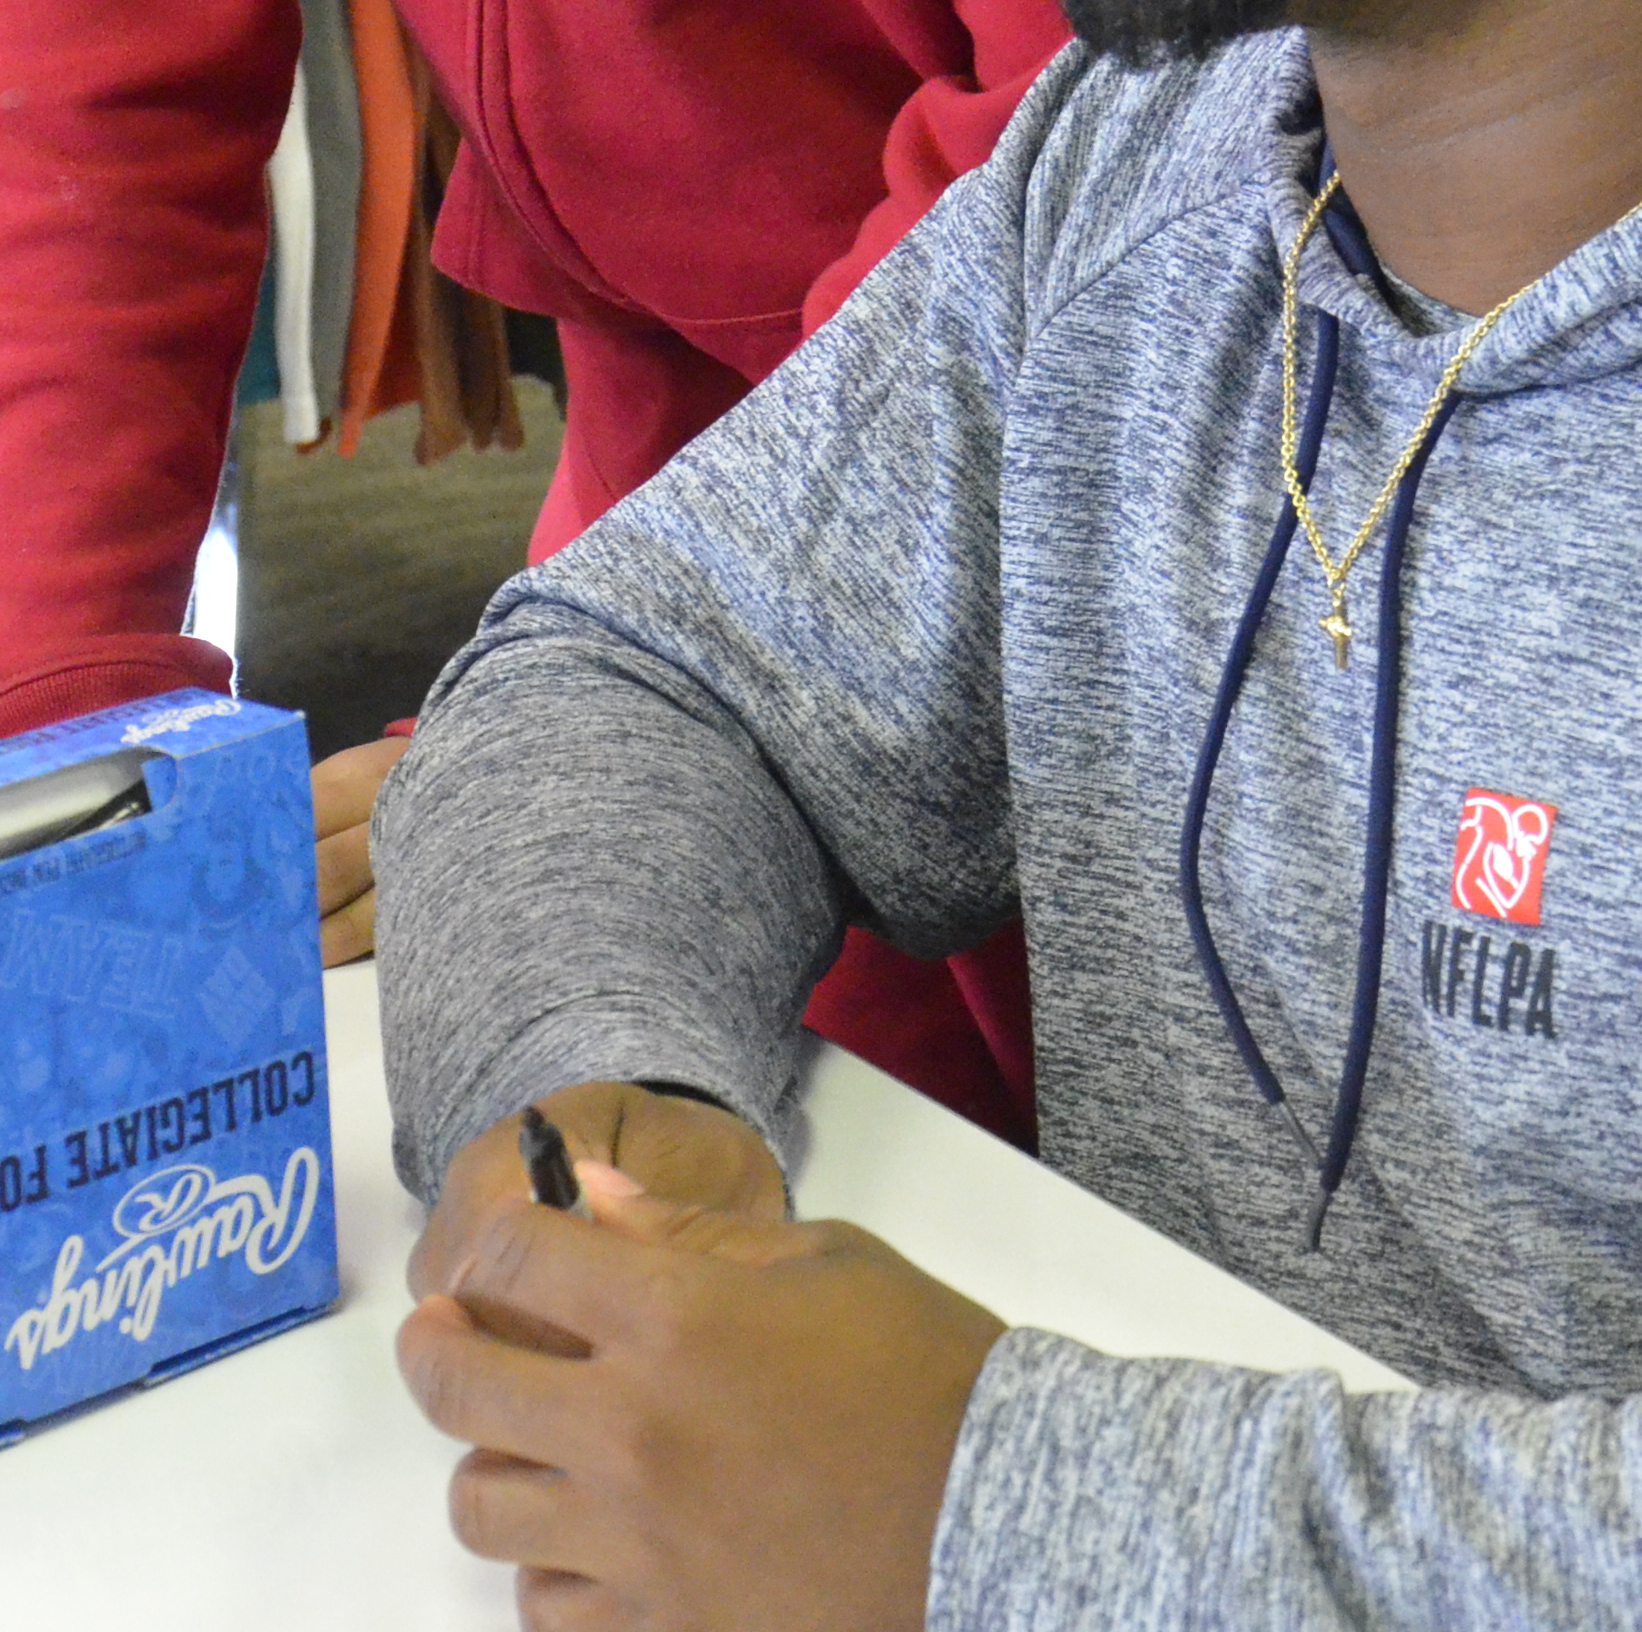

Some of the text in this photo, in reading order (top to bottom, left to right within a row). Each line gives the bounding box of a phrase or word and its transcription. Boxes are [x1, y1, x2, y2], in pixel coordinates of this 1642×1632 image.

[1421, 919, 1558, 1040] NFLPA
[65, 1049, 318, 1188] COLLEGIATE
[3, 1146, 320, 1371] Rawlings
